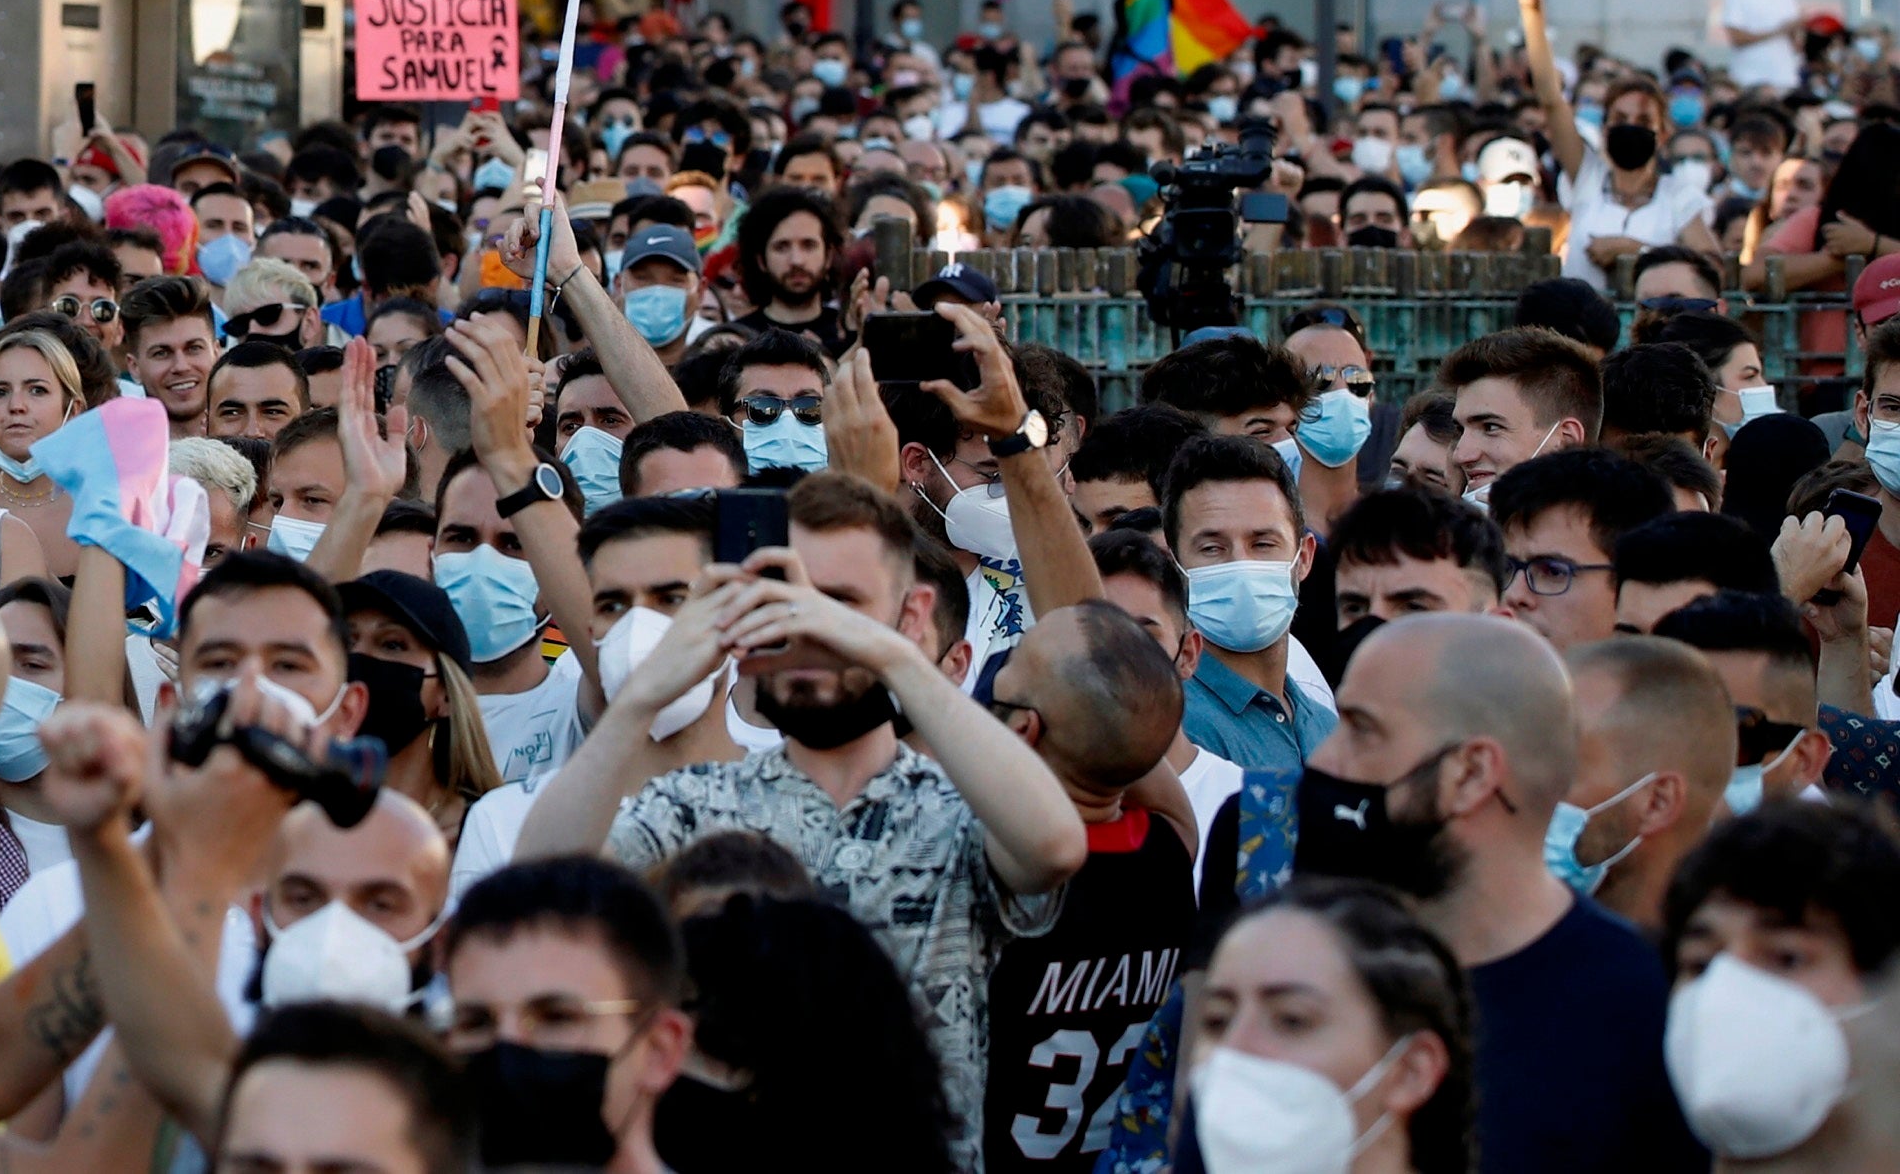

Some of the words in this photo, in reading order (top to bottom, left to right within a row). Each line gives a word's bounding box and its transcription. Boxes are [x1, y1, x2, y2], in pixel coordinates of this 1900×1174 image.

[401, 29, 466, 53] PARA
[380, 56, 498, 92] SAMUEL
[1026, 947, 1180, 1016] MIAMI
